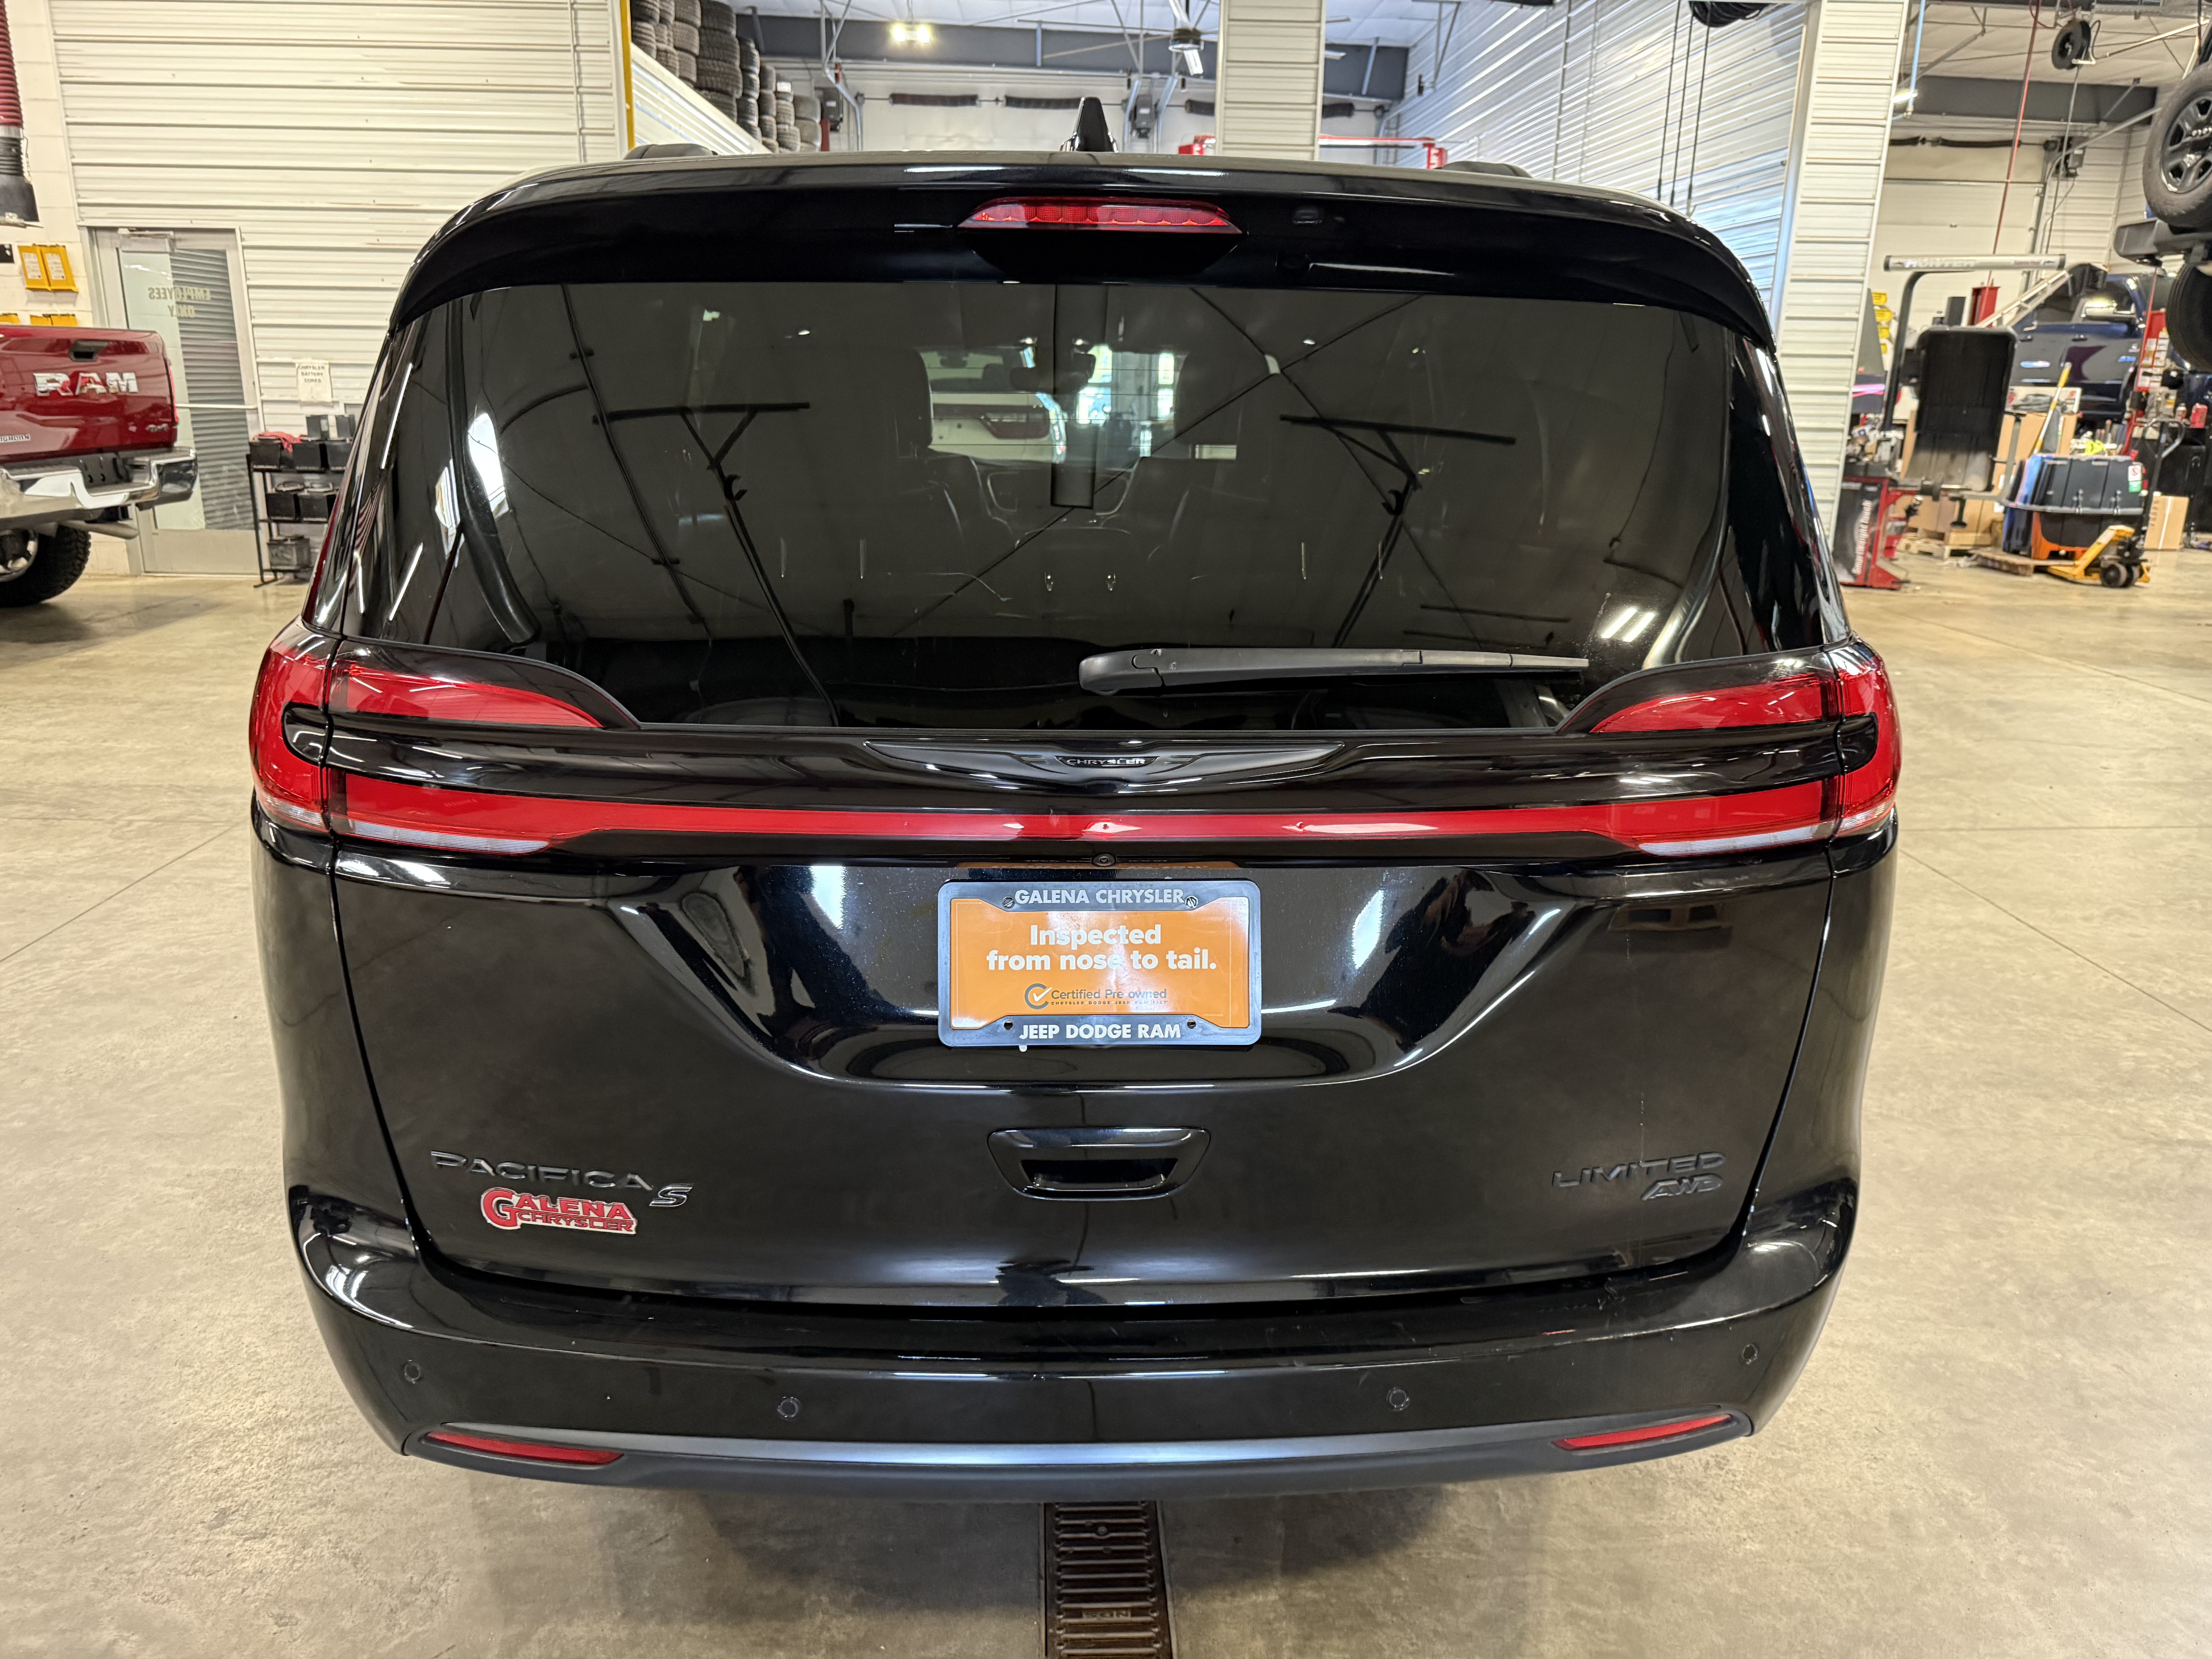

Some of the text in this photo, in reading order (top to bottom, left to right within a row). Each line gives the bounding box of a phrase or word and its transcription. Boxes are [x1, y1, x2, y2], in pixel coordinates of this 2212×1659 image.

[33, 372, 139, 397] RAM
[1014, 889, 1184, 904] GALENA CHRYSLER
[1030, 924, 1161, 950] Inspected
[986, 947, 1217, 970] from nose to tail.
[1051, 989, 1101, 999] Certified
[1019, 1024, 1181, 1039] JEEP DODGE RAM
[430, 1150, 694, 1207] PACIFICA S
[1552, 1151, 1726, 1188] LIMITED
[1640, 1173, 1723, 1200] AWD
[482, 1190, 631, 1227] GALENA
[517, 1211, 634, 1232] CHRYSLER
